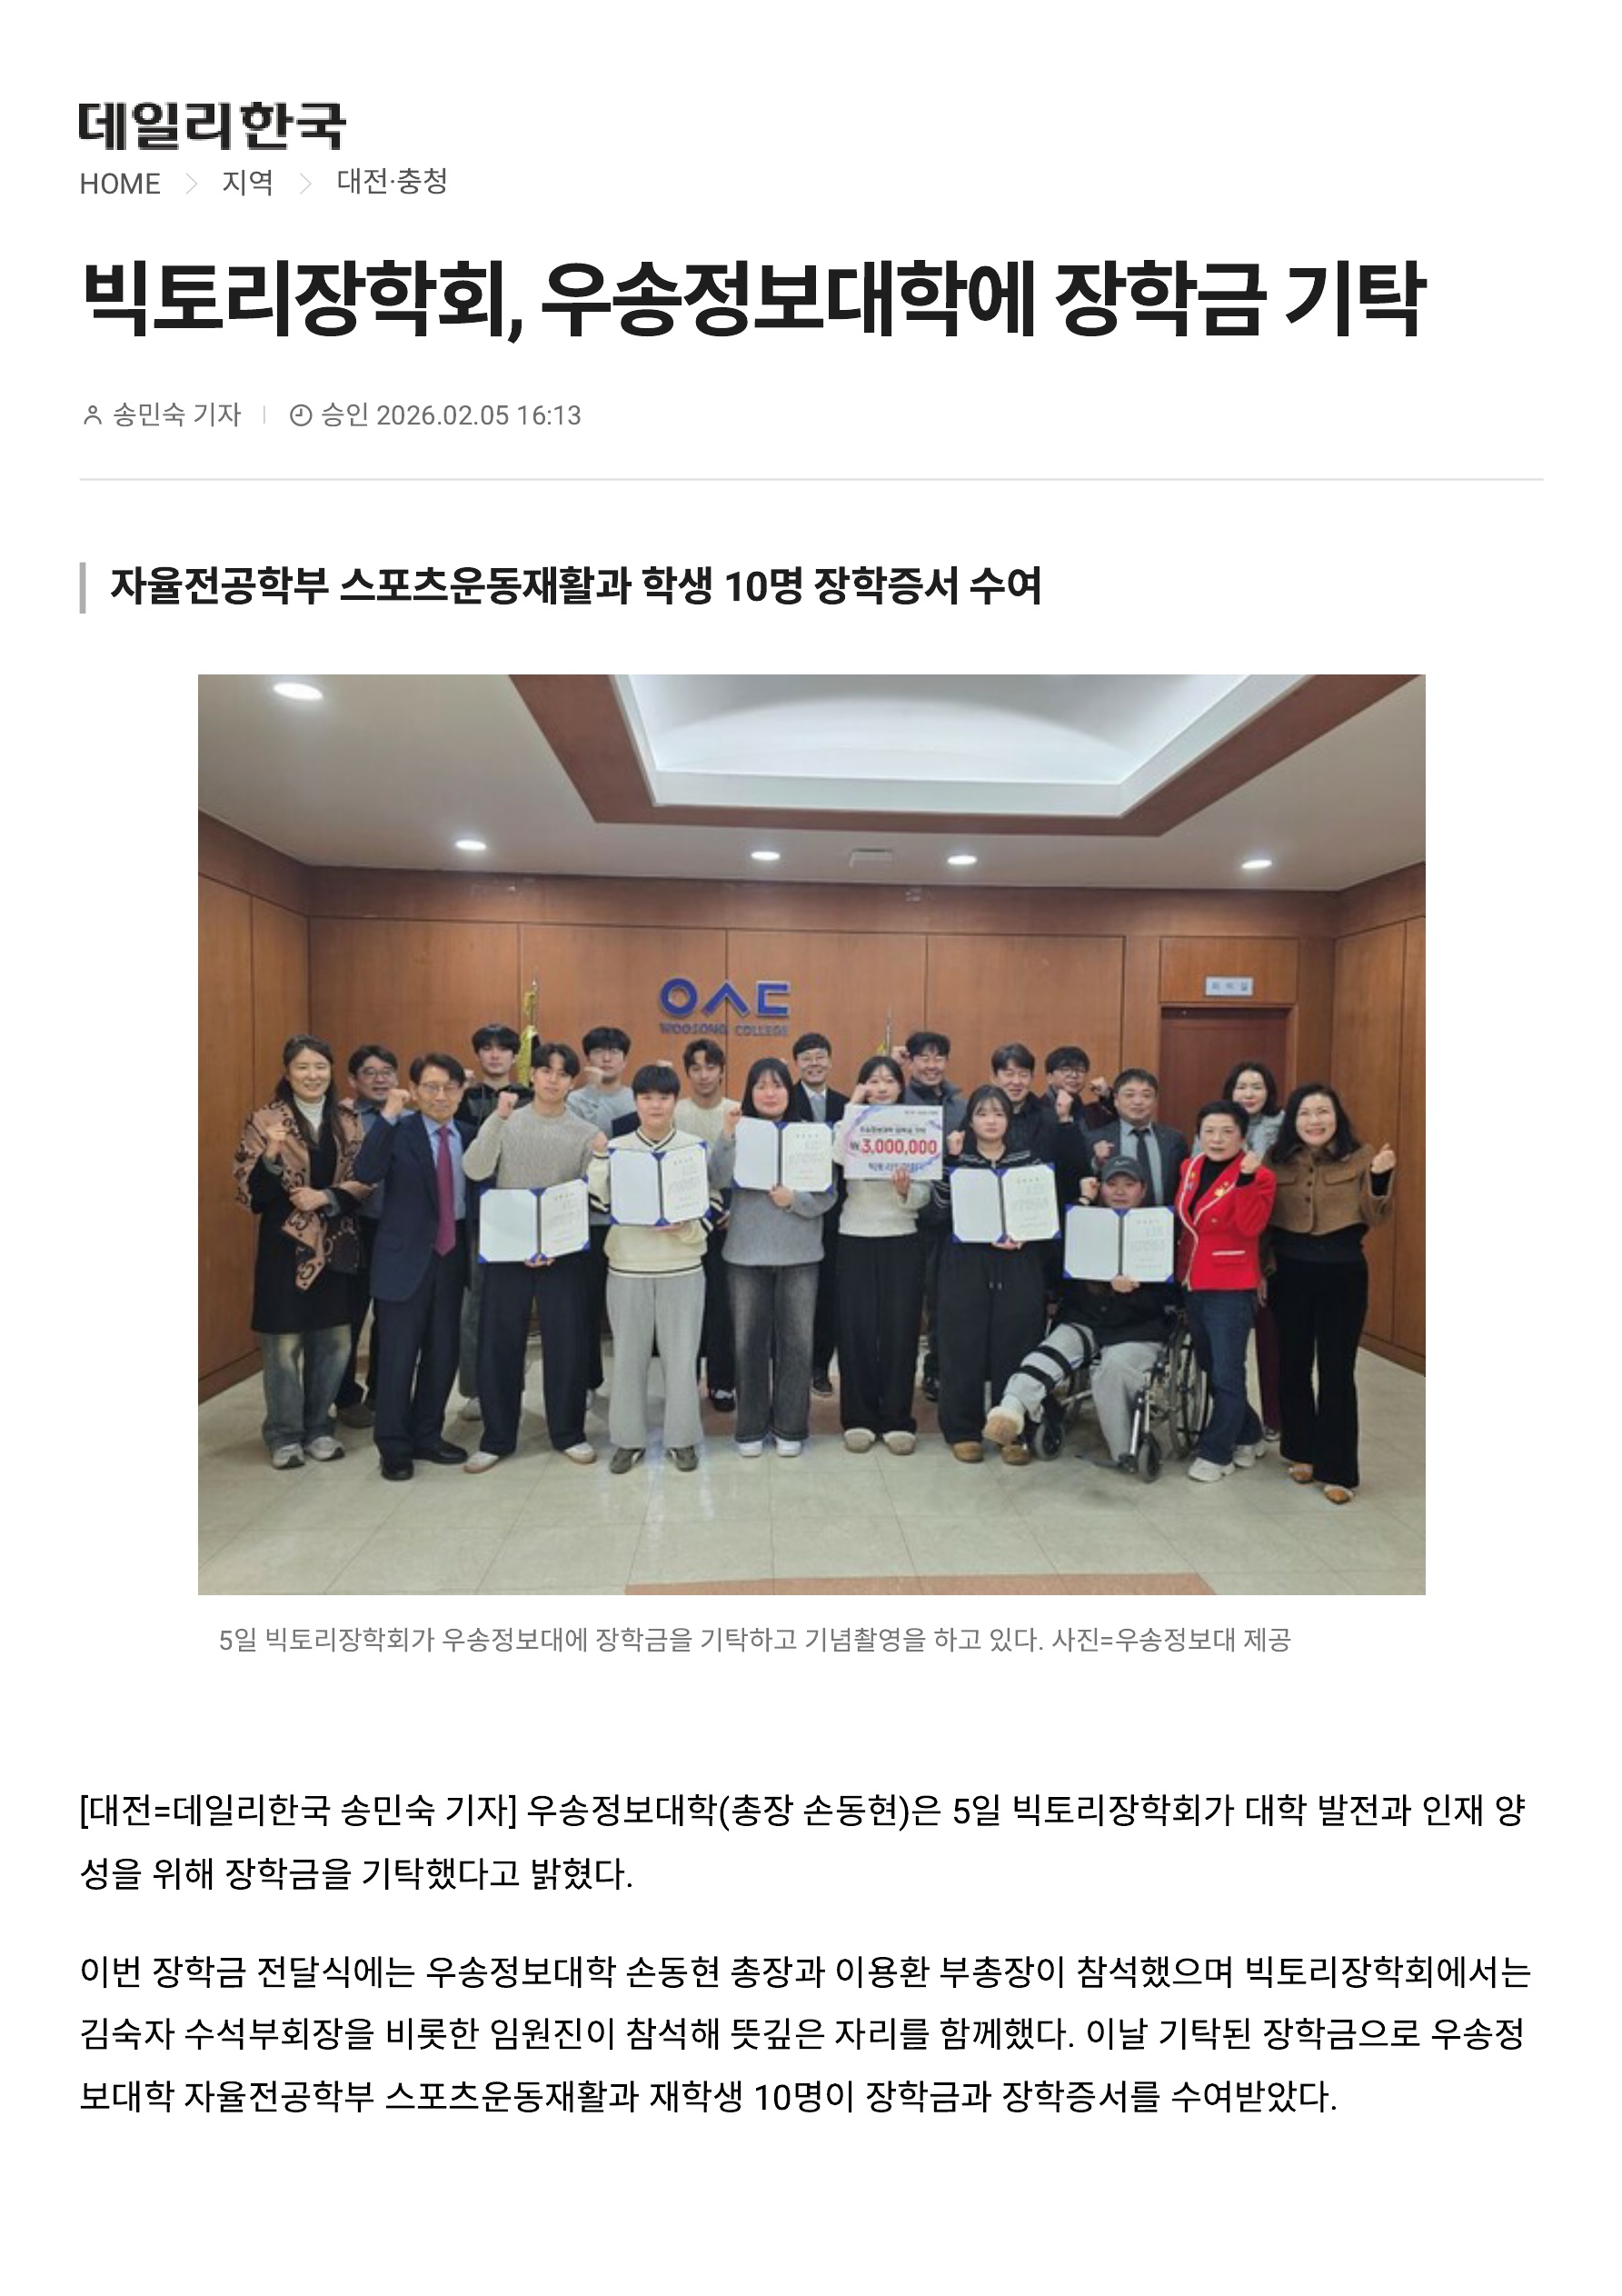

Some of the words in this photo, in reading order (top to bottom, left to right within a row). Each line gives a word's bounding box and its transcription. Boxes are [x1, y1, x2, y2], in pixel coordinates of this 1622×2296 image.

[79, 102, 346, 150] 데일리한국
[81, 173, 160, 194] HOME
[224, 170, 271, 196] 지역
[338, 168, 445, 195] 대전·충청
[86, 260, 522, 344] 빅토리장학회,
[542, 260, 1033, 336] 우송정보대학에
[1055, 260, 1267, 336] 장학금
[1286, 260, 1428, 336] 기탁
[114, 403, 185, 427] 송민숙
[194, 403, 241, 427] 기자
[322, 403, 367, 426] 승인
[377, 405, 509, 425] 2026.02.05
[518, 405, 581, 425] 16:13
[111, 566, 329, 604] 자율전공학부
[341, 566, 632, 604] 스포츠운동재활과
[642, 566, 711, 604] 학생
[726, 566, 801, 604] 10명
[814, 566, 957, 604] 장학증서
[970, 566, 1040, 604] 수여
[660, 1023, 728, 1035] WOOSONG
[735, 1023, 788, 1036] COLLEGE
[220, 1628, 255, 1652] 5일
[267, 1627, 434, 1652] 빅토리장학회가
[443, 1628, 586, 1652] 우송정보대에
[596, 1627, 692, 1652] 장학금을
[702, 1628, 797, 1652] 기탁하고
[806, 1628, 926, 1652] 기념촬영을
[934, 1628, 981, 1652] 하고
[990, 1628, 1043, 1652] 있다.
[1052, 1628, 1234, 1652] 사진=우송정보대
[1244, 1628, 1291, 1652] 제공
[81, 1794, 331, 1829] [대전=데일리한국
[342, 1794, 434, 1826] 송민숙
[446, 1794, 515, 1829] 기자]
[528, 1794, 793, 1832] 우송정보대학(총장
[804, 1794, 940, 1832] 손동현)은
[954, 1794, 1000, 1826] 5일
[1014, 1794, 1234, 1826] 빅토리장학회가
[1247, 1794, 1307, 1826] 대학
[1319, 1794, 1411, 1826] 발전과
[1423, 1794, 1482, 1826] 인재
[1496, 1794, 1525, 1826] 양
[81, 1858, 141, 1890] 성을
[154, 1858, 212, 1890] 위해
[226, 1858, 351, 1890] 장학금을
[363, 1858, 519, 1890] 기탁했다고
[532, 1858, 632, 1890] 밝혔다.
[82, 1956, 139, 1988] 이번
[154, 1956, 246, 1988] 장학금
[258, 1956, 414, 1988] 전달식에는
[427, 1956, 616, 1988] 우송정보대학
[627, 1956, 718, 1988] 손동현
[731, 1956, 825, 1988] 총장과
[837, 1956, 930, 1988] 이용환
[940, 1956, 1062, 1988] 부총장이
[1078, 1956, 1231, 1988] 참석했으며
[1247, 1956, 1530, 1988] 빅토리장학회에서는
[81, 2018, 174, 2050] 김숙자
[185, 2018, 373, 2050] 수석부회장을
[388, 2018, 479, 2050] 비롯한
[491, 2018, 612, 2050] 임원진이
[627, 2018, 718, 2050] 참석해
[731, 2018, 824, 2050] 뜻깊은
[835, 2018, 929, 2050] 자리를
[940, 2018, 1073, 2050] 함께했다.
[1088, 2018, 1148, 2050] 이날
[1159, 2018, 1250, 2050] 기탁된
[1264, 2018, 1420, 2050] 장학금으로
[1432, 2018, 1522, 2050] 우송정
[81, 2081, 174, 2112] 보대학
[184, 2081, 373, 2112] 자율전공학부
[386, 2081, 639, 2112] 스포츠운동재활과
[650, 2081, 741, 2112] 재학생
[756, 2081, 851, 2112] 10명이
[867, 2081, 991, 2112] 장학금과
[1003, 2081, 1159, 2112] 장학증서를
[1172, 2081, 1336, 2112] 수여받았다.
